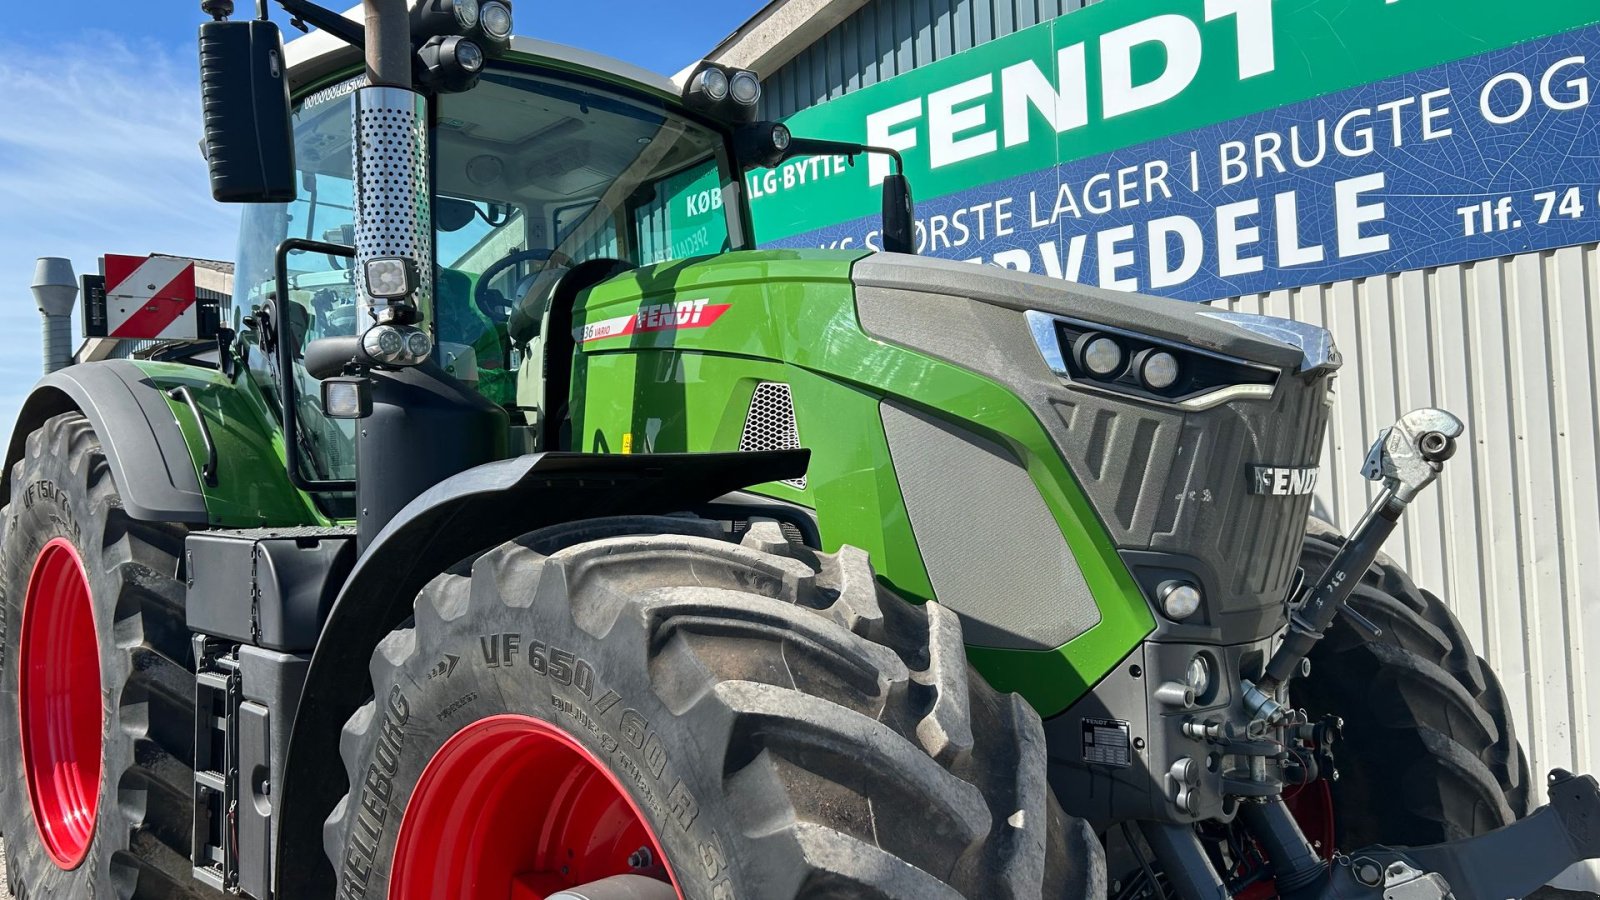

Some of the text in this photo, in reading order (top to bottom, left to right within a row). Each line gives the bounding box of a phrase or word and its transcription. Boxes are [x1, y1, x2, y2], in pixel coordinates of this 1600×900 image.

[866, 0, 1275, 188] FENDT
[1029, 160, 1172, 228] LAGER
[1190, 151, 1199, 192] I
[1220, 88, 1453, 186] BRUGTE
[1479, 56, 1590, 124] OG
[1457, 187, 1585, 237] Tlf. 74
[594, 326, 611, 337] VARIO
[636, 298, 710, 329] FENDT
[480, 632, 521, 668] VF
[340, 683, 410, 900] RELLEBORG
